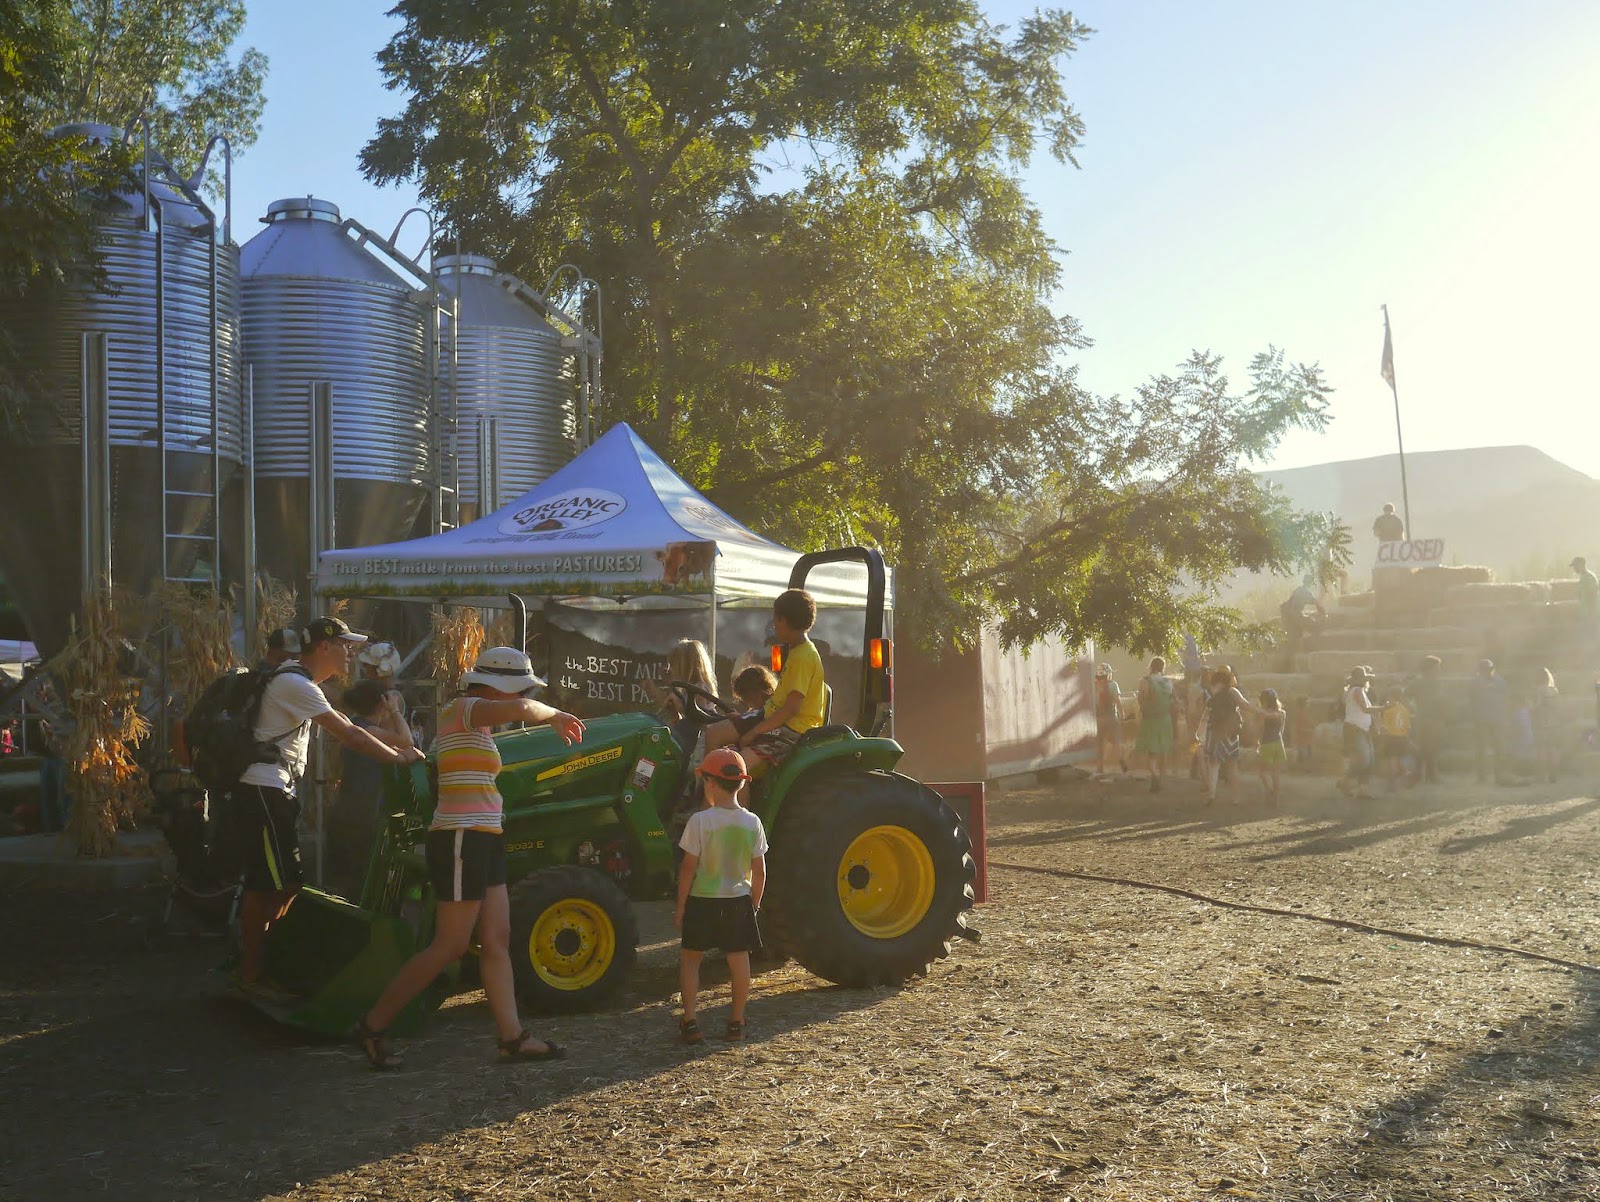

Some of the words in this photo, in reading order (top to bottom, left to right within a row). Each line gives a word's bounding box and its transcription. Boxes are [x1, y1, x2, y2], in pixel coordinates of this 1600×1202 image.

[512, 497, 620, 521] ORGANIC
[516, 508, 600, 526] VALLEY
[1378, 539, 1444, 562] CLOSED
[332, 562, 360, 575] The
[364, 559, 400, 575] BEST
[401, 562, 438, 575] milk
[443, 562, 480, 576] from
[484, 561, 510, 574] the
[514, 562, 549, 574] best
[552, 554, 642, 574] PASTURES!
[565, 656, 586, 672] the
[586, 656, 632, 677] BEST
[559, 675, 580, 690] the
[586, 680, 624, 702] BEST
[561, 761, 587, 774] JOHN
[587, 750, 619, 765] DEERE
